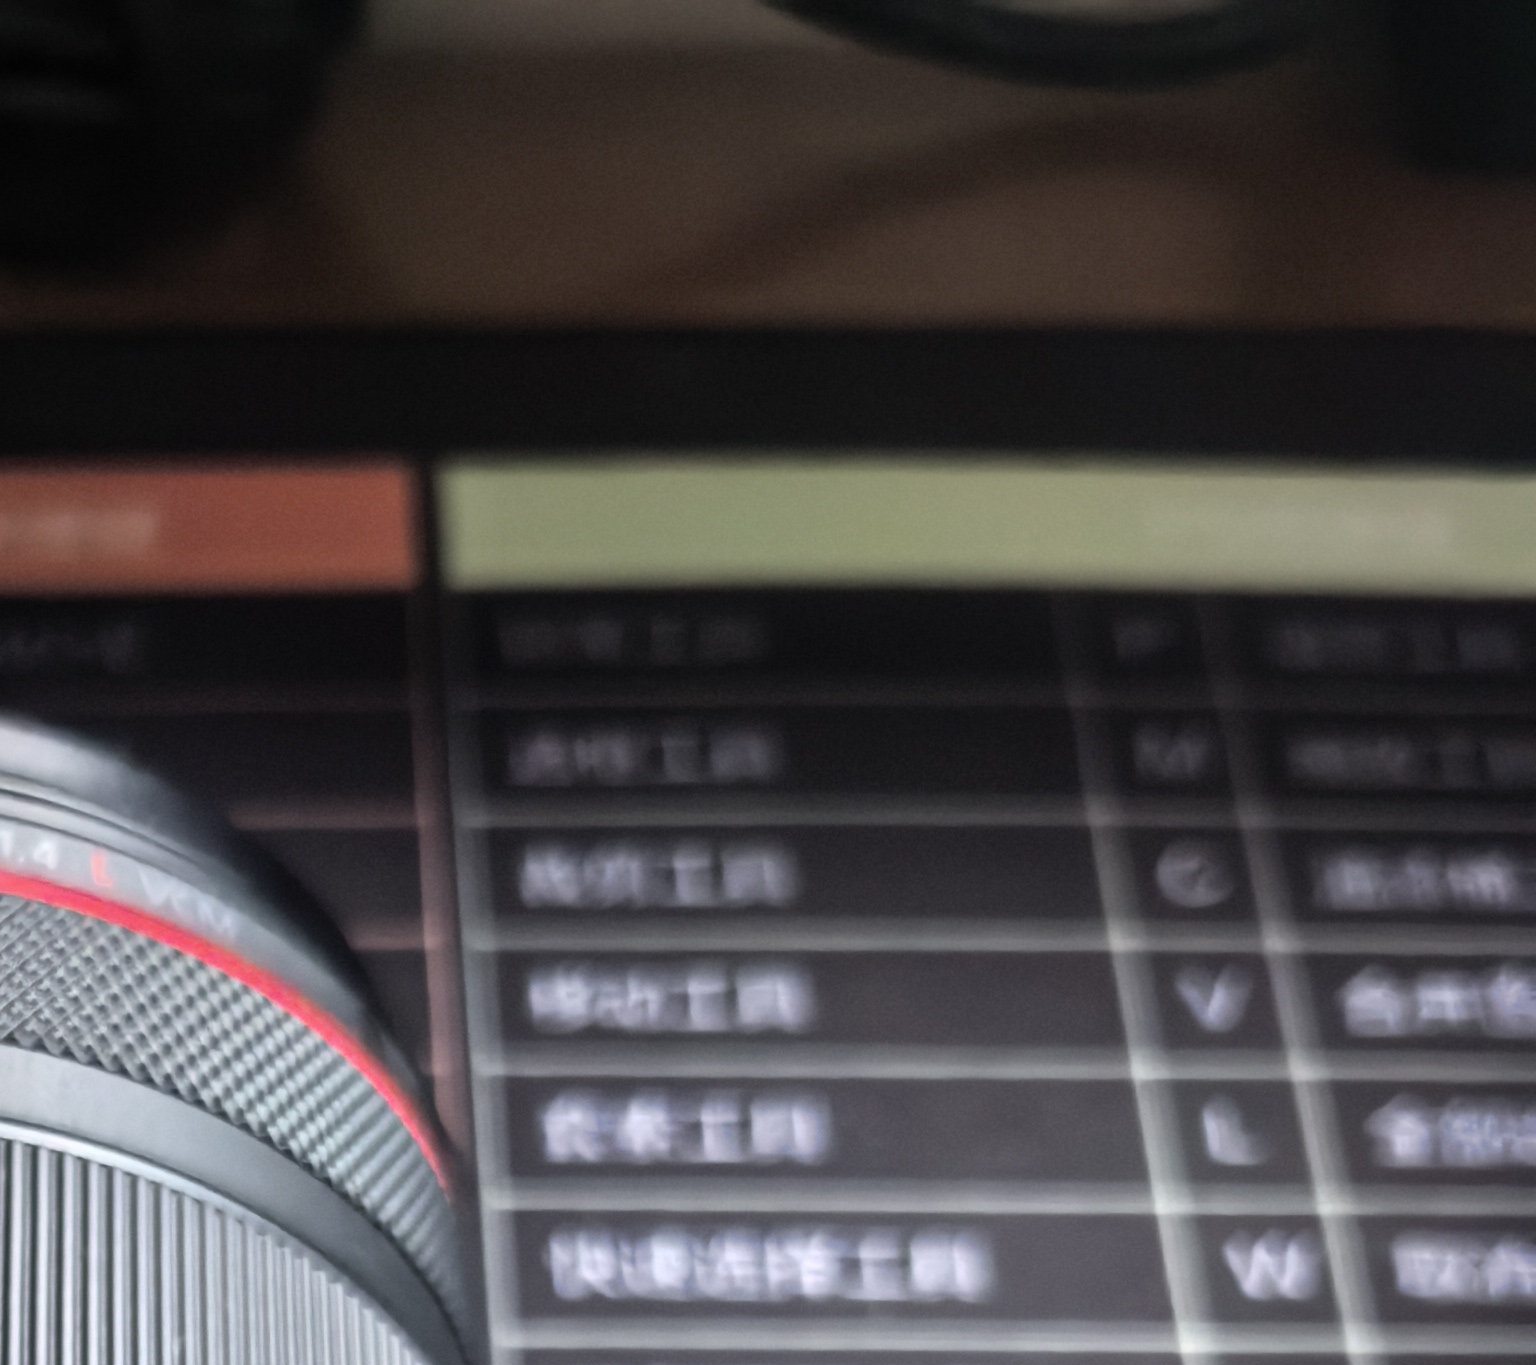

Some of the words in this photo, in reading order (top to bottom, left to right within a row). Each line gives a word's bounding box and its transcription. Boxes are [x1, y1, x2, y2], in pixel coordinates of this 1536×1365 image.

[89, 847, 115, 889] L
[1152, 845, 1232, 911] C
[1175, 974, 1247, 1034] V
[1198, 1102, 1261, 1168] L
[1221, 1230, 1322, 1302] W
